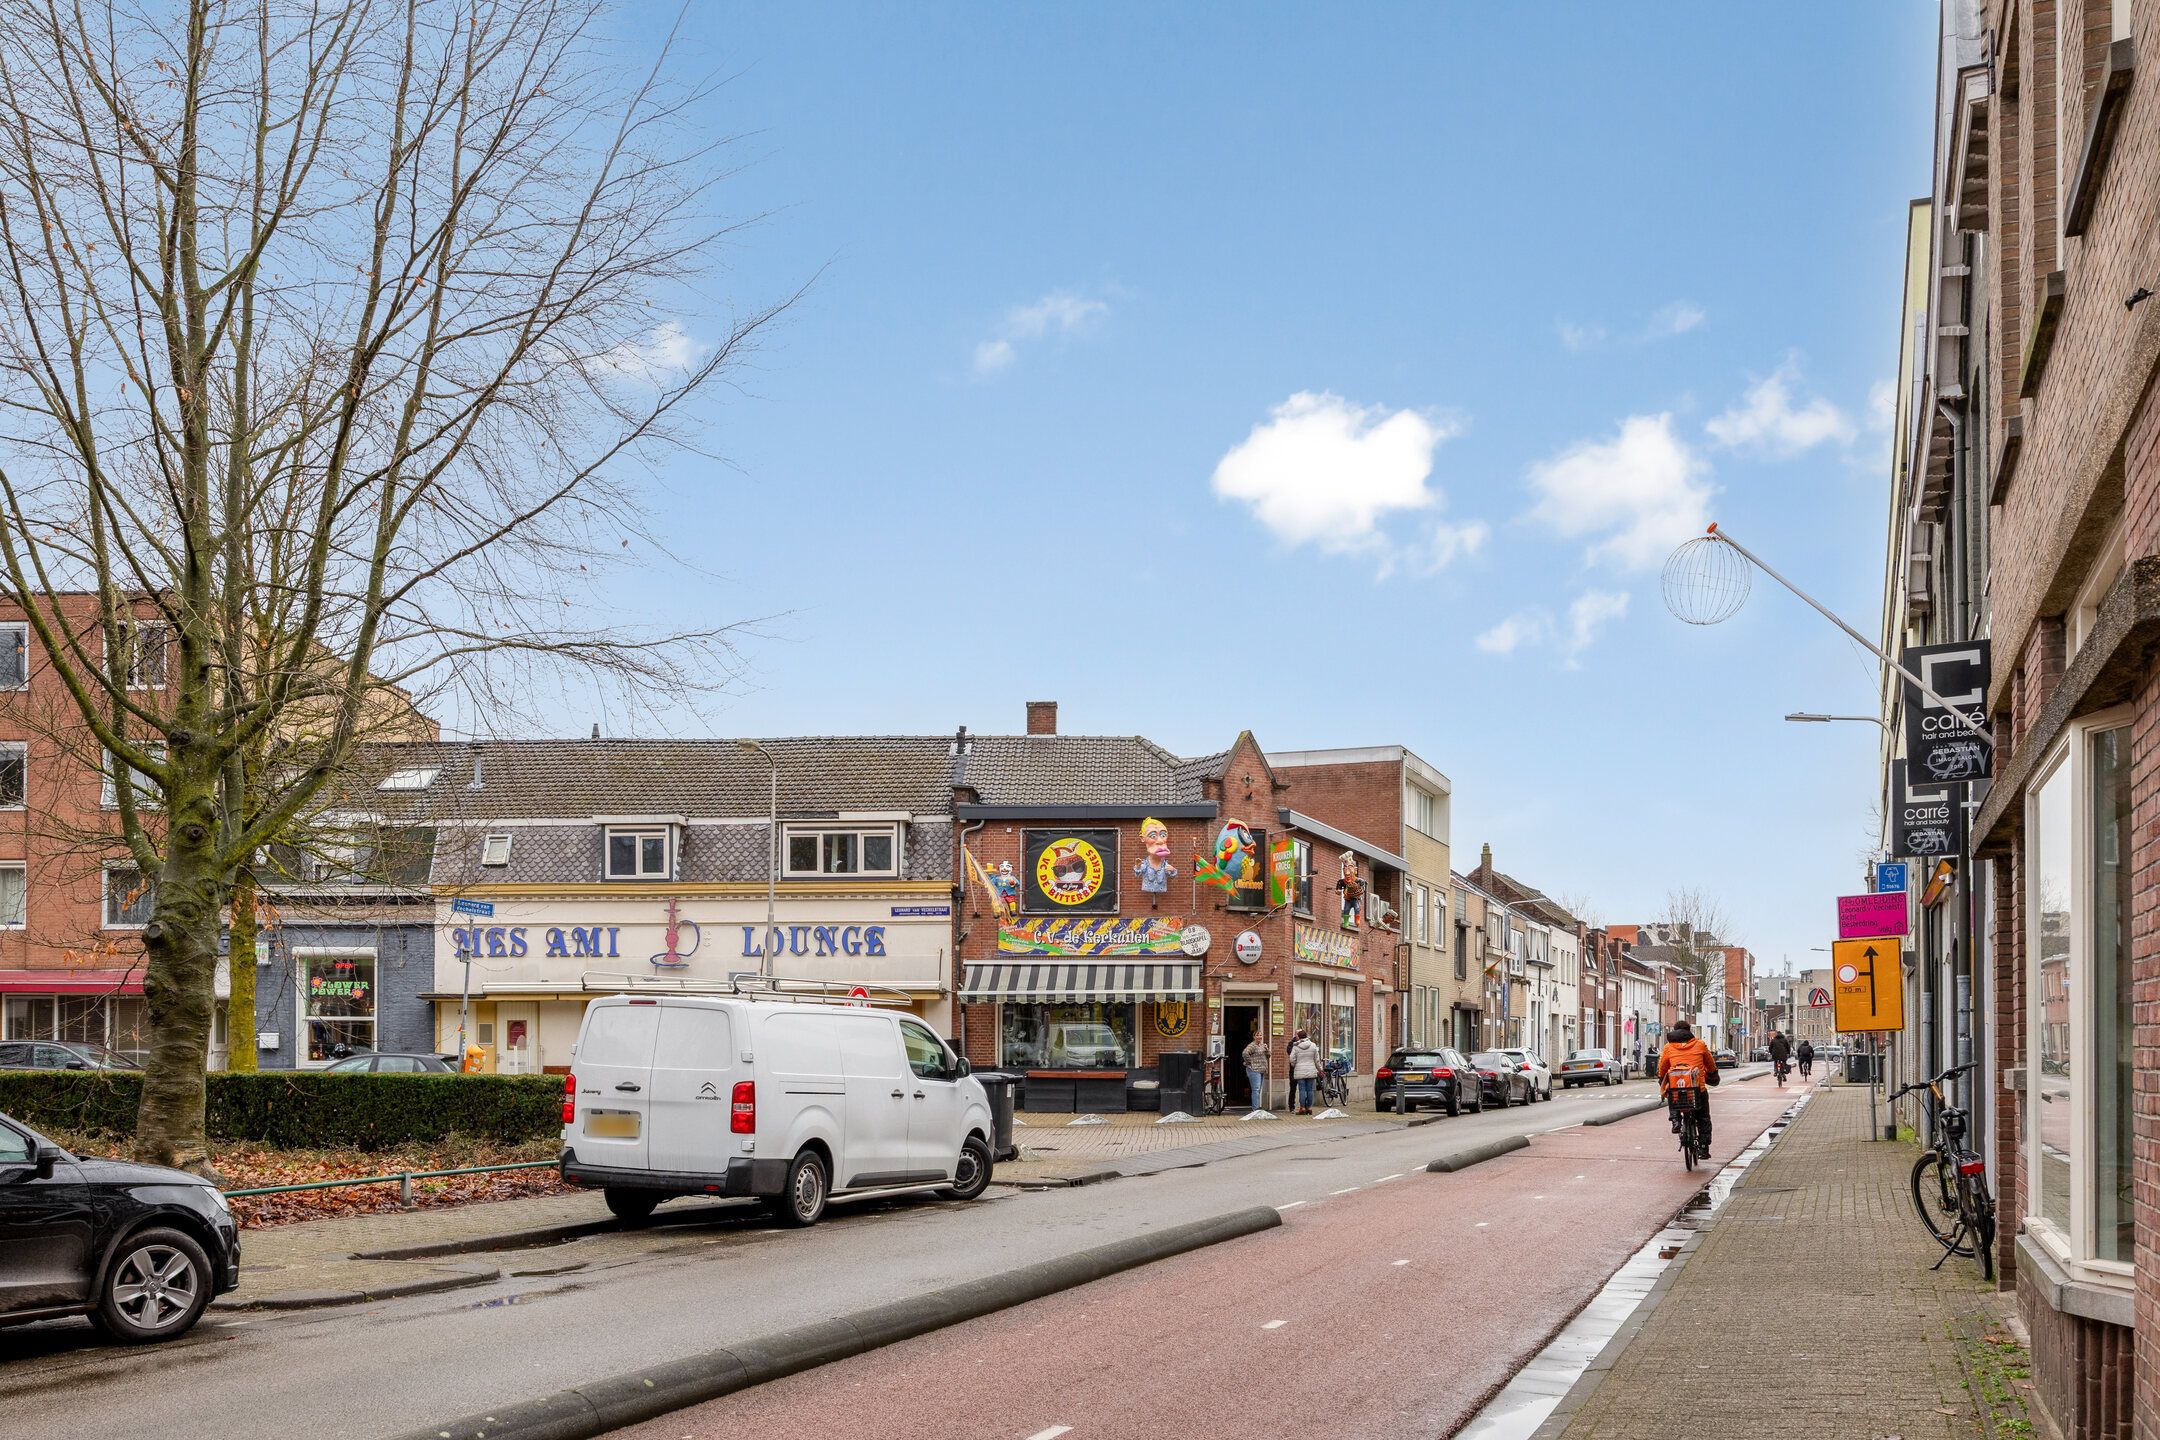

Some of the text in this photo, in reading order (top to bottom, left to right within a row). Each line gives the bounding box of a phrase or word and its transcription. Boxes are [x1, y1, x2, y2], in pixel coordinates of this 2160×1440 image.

[1922, 706, 1986, 732] carré
[1922, 732, 1937, 740] hair
[1939, 729, 1955, 739] and
[1932, 745, 1980, 755] SEBASTIAN
[1904, 803, 1950, 820] carré
[1040, 849, 1101, 902] VC DE BITTERBALLEKES
[452, 925, 887, 958] MES AMI LOUNGE
[1064, 929, 1080, 944] de
[1082, 929, 1150, 944] Kerkuilen
[311, 987, 352, 996] POWER
[321, 981, 369, 990] FLOWER
